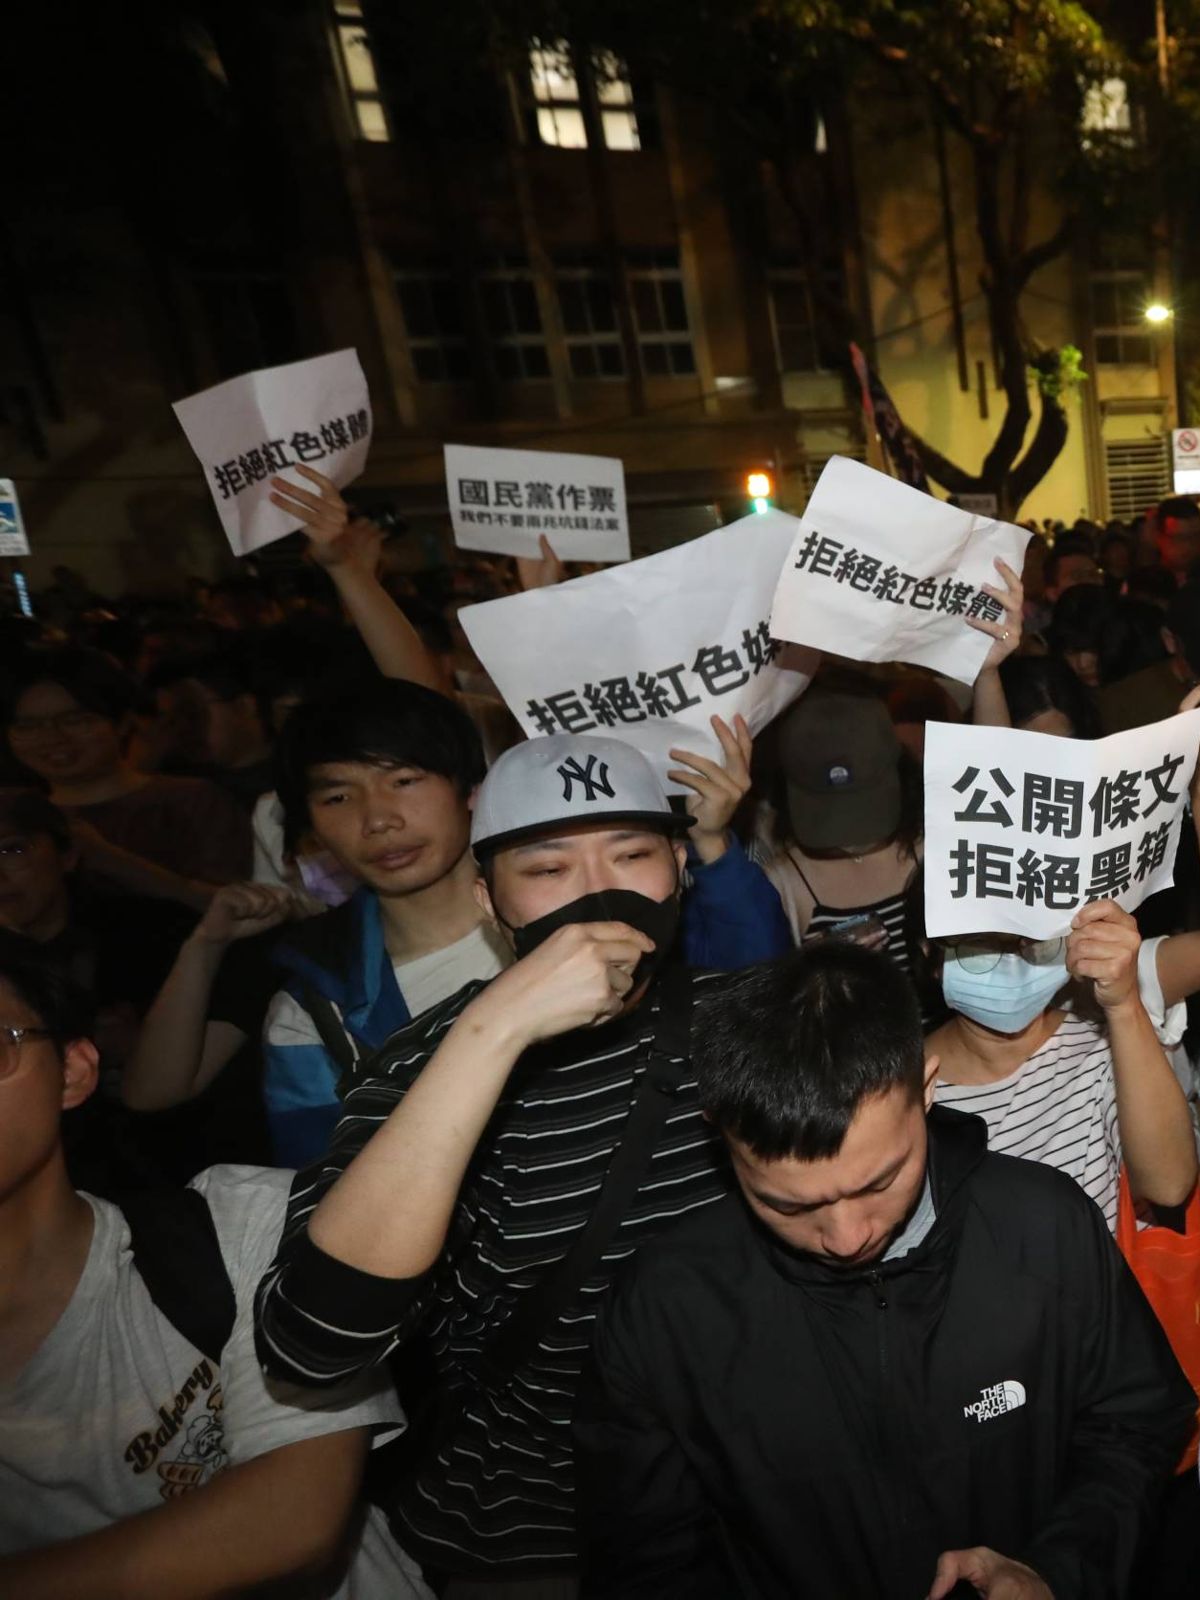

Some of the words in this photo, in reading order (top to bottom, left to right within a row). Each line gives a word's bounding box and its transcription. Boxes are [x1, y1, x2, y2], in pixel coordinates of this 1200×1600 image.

[214, 409, 368, 499] 拒絕紅色媒體
[458, 478, 617, 512] 國民黨作票
[795, 531, 1005, 623] 拒絕紅色媒體
[557, 754, 616, 803] NY
[952, 754, 1185, 839] 公開條文
[949, 820, 1174, 909] 拒絕黑箱
[124, 1359, 214, 1474] Bakery
[963, 1393, 1006, 1418] NORTH
[977, 1403, 1007, 1423] FACE
[980, 1382, 1004, 1401] THE
